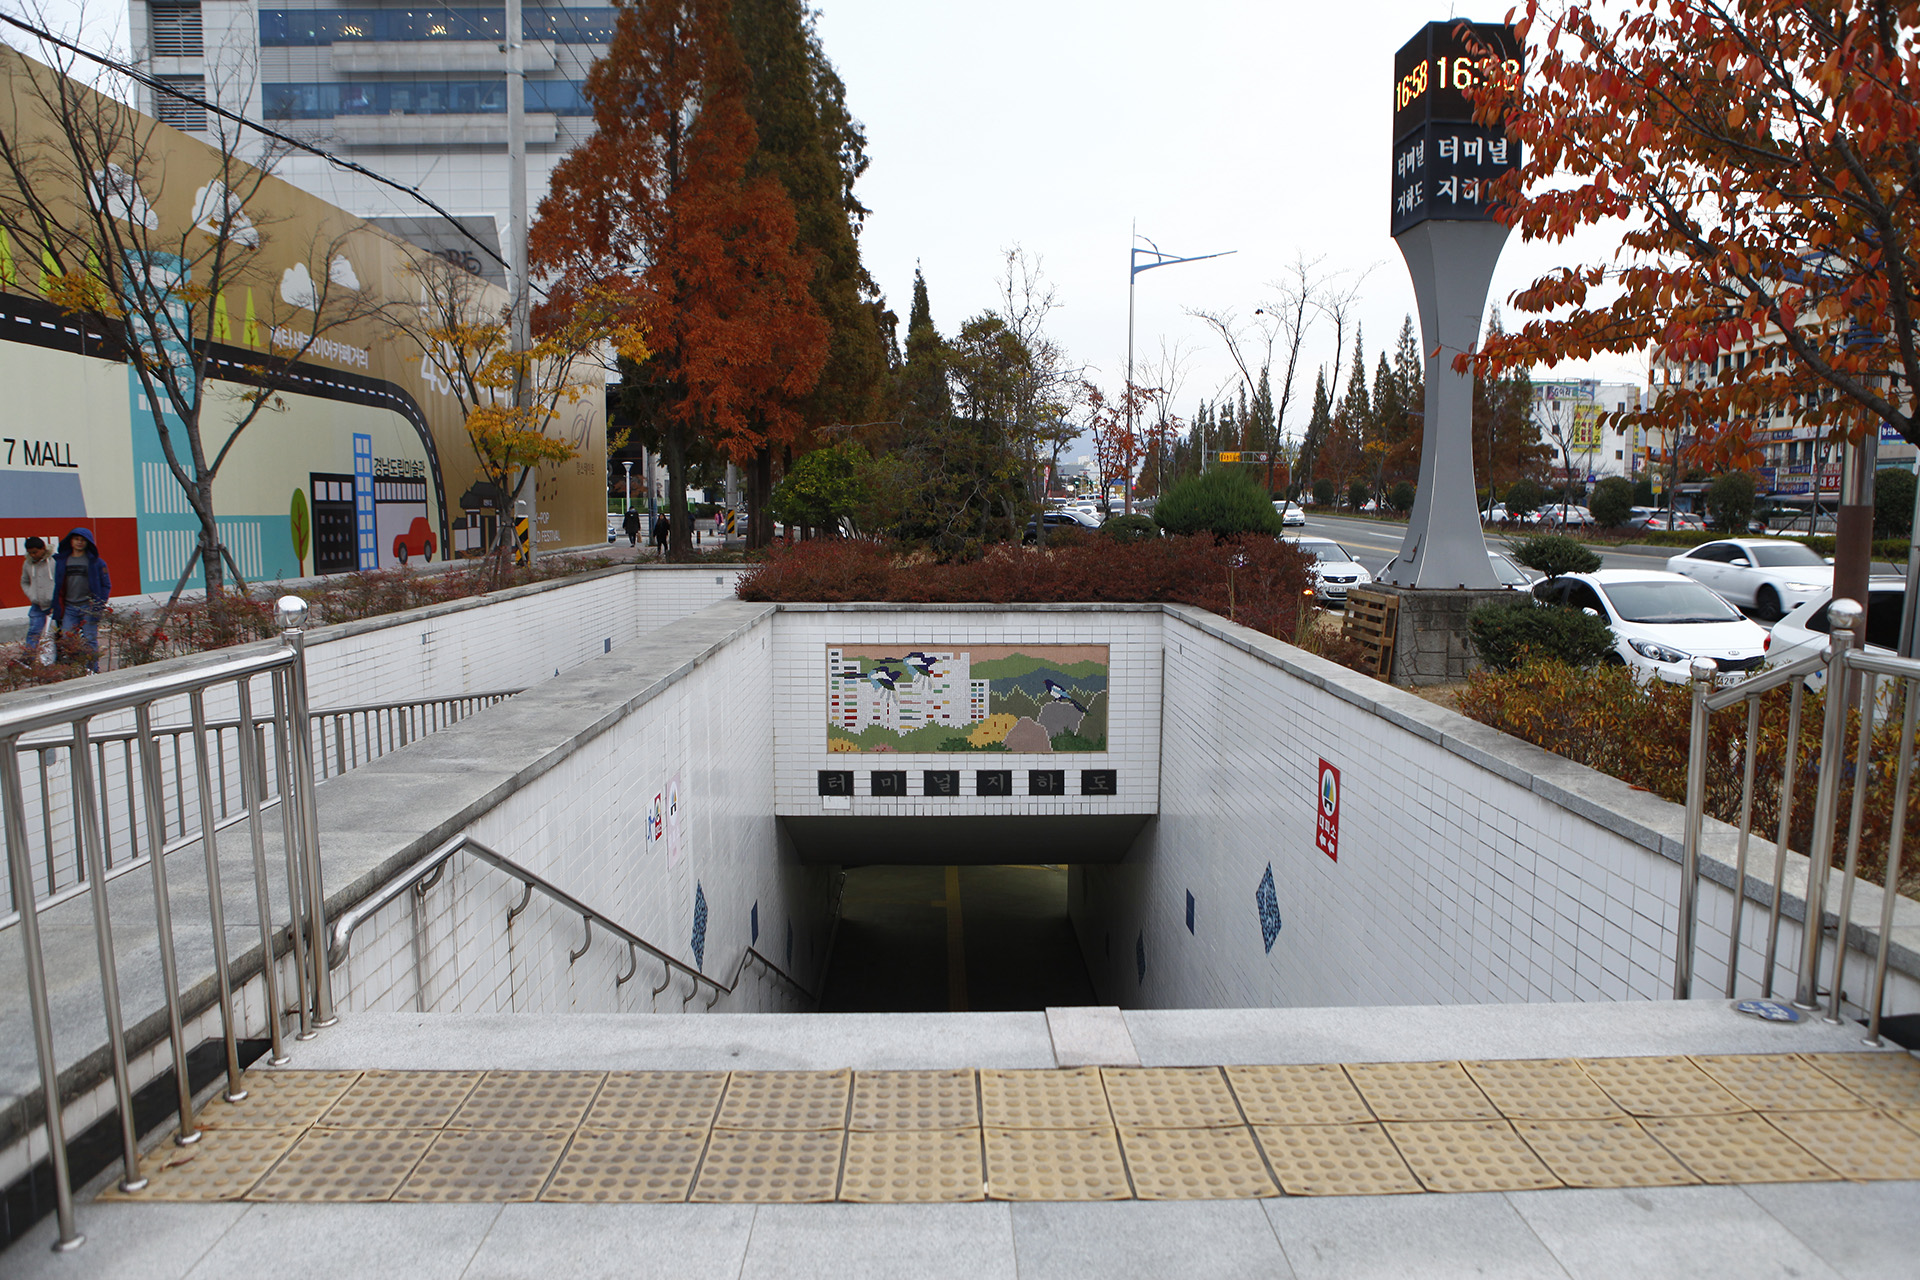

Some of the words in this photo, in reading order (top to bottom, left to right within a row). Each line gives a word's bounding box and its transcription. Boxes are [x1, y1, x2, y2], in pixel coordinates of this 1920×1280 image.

[1396, 59, 1428, 112] 16:58
[1397, 139, 1425, 179] 터미널
[1438, 135, 1509, 166] 터미널
[1396, 181, 1424, 217] 지하도
[3, 437, 16, 465] 7
[23, 439, 79, 468] MALL
[1319, 814, 1337, 840] 대피소
